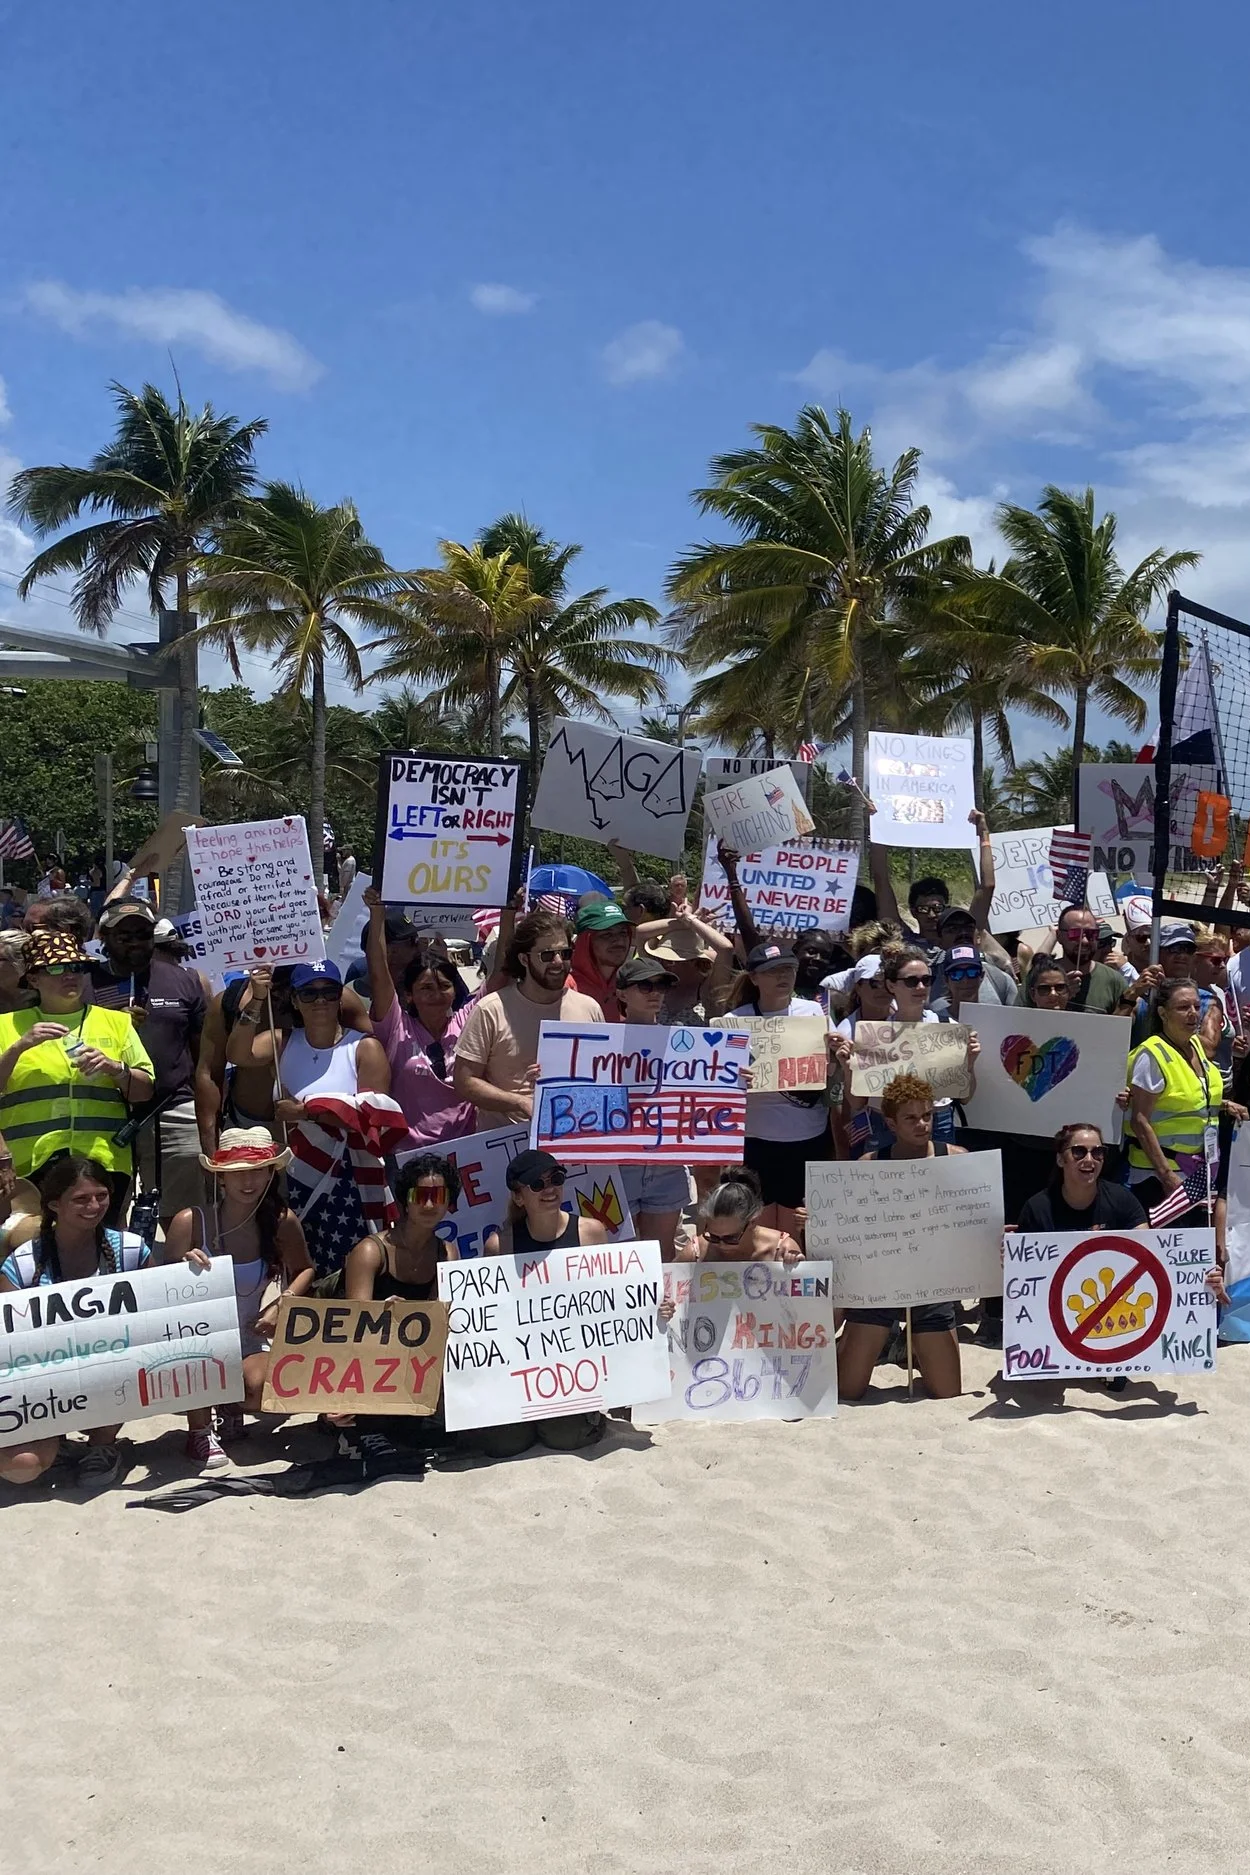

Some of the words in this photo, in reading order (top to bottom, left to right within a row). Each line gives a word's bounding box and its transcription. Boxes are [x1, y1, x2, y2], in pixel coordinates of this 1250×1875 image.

[874, 736, 905, 757] NO
[391, 759, 515, 787] DEMOCRACY
[722, 759, 741, 774] NO
[430, 785, 492, 806] ISN'T
[876, 777, 890, 790] IN
[900, 779, 956, 796] AMERICA
[711, 786, 750, 819] FIRE
[391, 804, 447, 828] LEFT
[462, 808, 514, 830] RIGHT
[194, 830, 237, 849] feeling
[212, 849, 243, 862] hope
[247, 843, 271, 857] this
[272, 835, 304, 851] helps
[430, 840, 470, 859] IT'S
[238, 863, 274, 877] strong
[277, 858, 295, 869] and
[776, 851, 848, 874] PEOPLE
[408, 862, 492, 895] OURS
[742, 869, 816, 891] UNITED
[200, 887, 232, 901] afraid
[756, 890, 820, 912] NEVER
[823, 898, 848, 914] BE
[205, 909, 241, 927] LORD
[268, 901, 287, 913] God
[294, 943, 308, 954] U
[536, 1031, 739, 1095] Immigrants
[1016, 1050, 1061, 1075] FDT
[550, 1094, 663, 1150] Belong
[676, 1095, 739, 1143] Here
[1006, 1236, 1060, 1262] WE'VE
[1157, 1234, 1184, 1249] WE
[521, 1259, 550, 1288] MI
[565, 1249, 644, 1282] FAMILIA
[1166, 1249, 1212, 1265] SURE
[3, 1280, 139, 1334] MAGA
[164, 1281, 209, 1304] has
[448, 1303, 498, 1334] QUE
[516, 1287, 615, 1326] LLEGARON
[625, 1281, 658, 1310] SIN
[1177, 1292, 1215, 1307] NEED
[285, 1306, 431, 1348] DEMO
[1016, 1305, 1034, 1324] A
[1186, 1311, 1198, 1324] A
[162, 1321, 210, 1342] the
[446, 1340, 510, 1373] NADA,
[516, 1334, 531, 1360] Y
[541, 1326, 575, 1357] ME
[581, 1315, 654, 1350] DIERON
[668, 1315, 716, 1354] NO
[731, 1312, 830, 1350] KINGS
[1005, 1343, 1059, 1375] FOOL
[272, 1353, 437, 1398] CRAZY
[510, 1355, 609, 1402] TODO!
[685, 1355, 813, 1410] 8647
[0, 1389, 88, 1434] Statue
